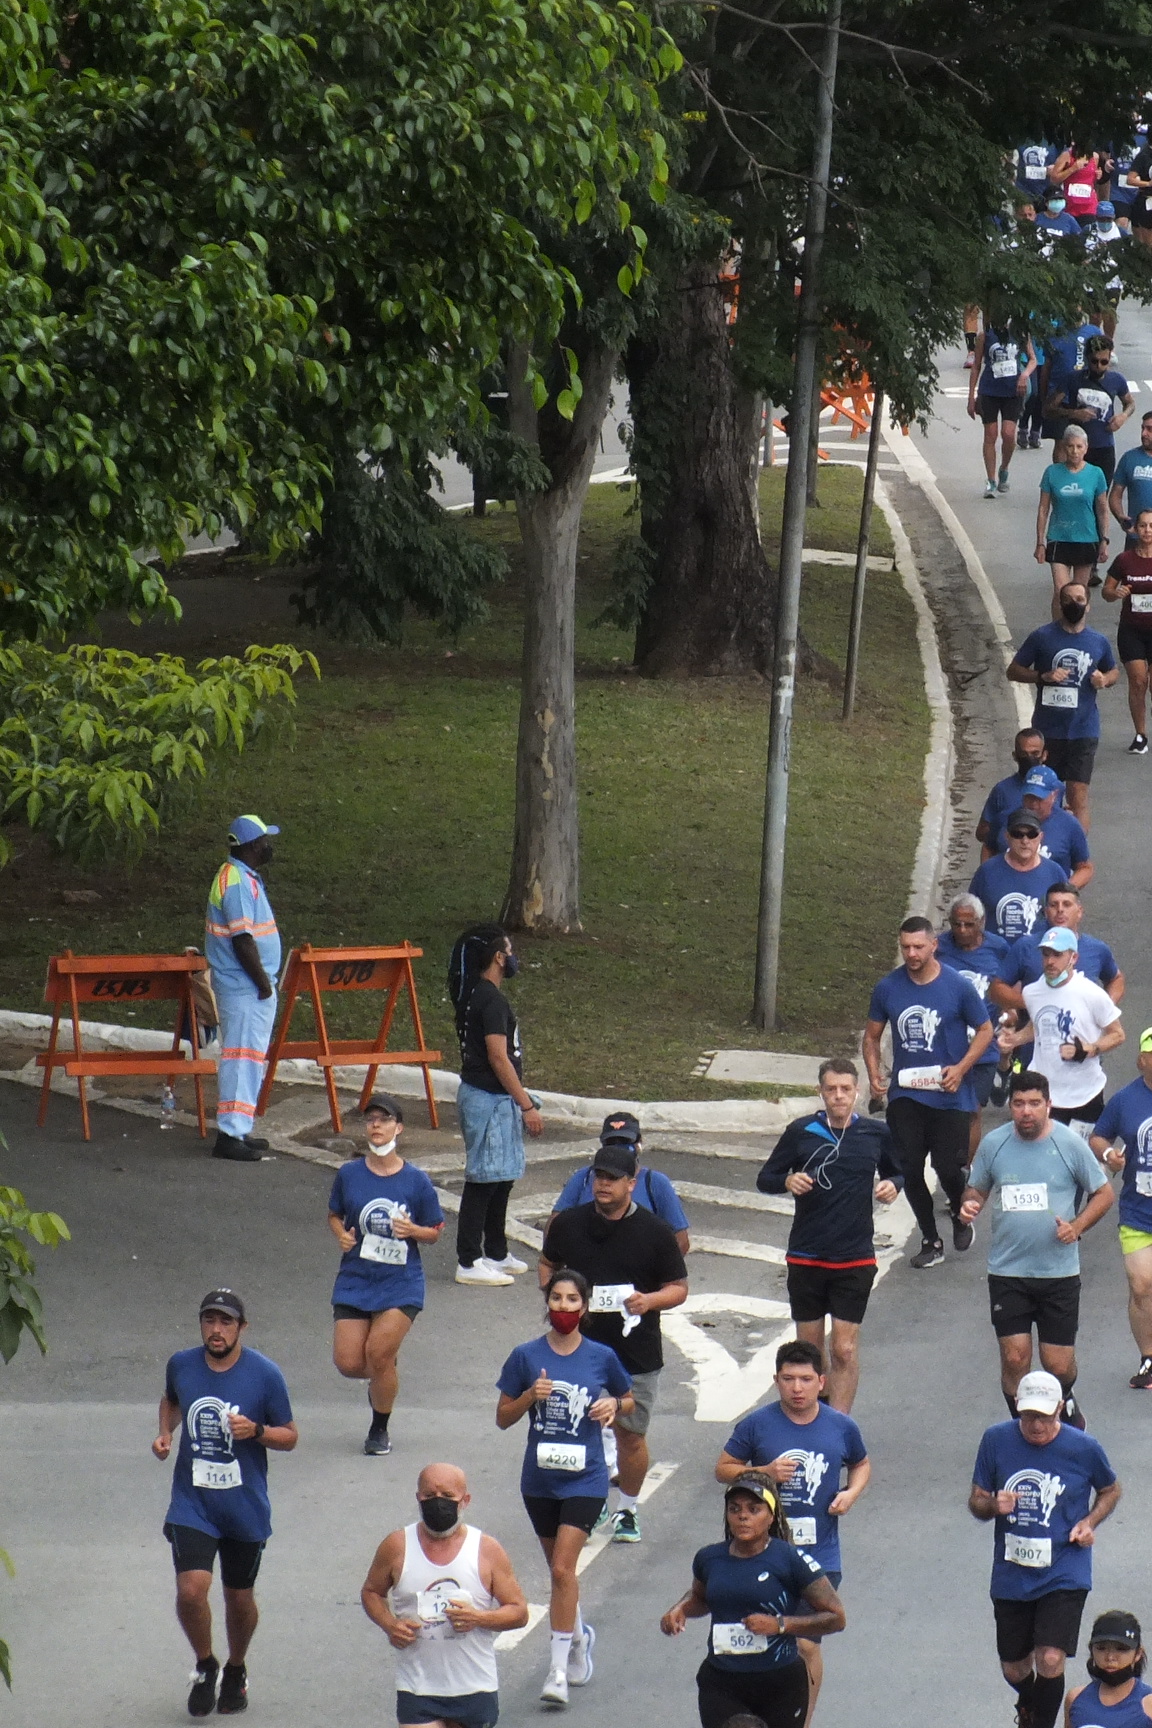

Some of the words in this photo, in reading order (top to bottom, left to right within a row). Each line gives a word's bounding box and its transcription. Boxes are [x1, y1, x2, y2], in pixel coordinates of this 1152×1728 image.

[328, 961, 375, 985] BJB
[1012, 1192, 1039, 1206] 1539
[373, 1245, 401, 1259] 4172
[546, 1455, 577, 1467] 4220
[206, 1470, 233, 1483] 1141
[1014, 1548, 1042, 1560] 4907
[731, 1634, 754, 1647] 562
